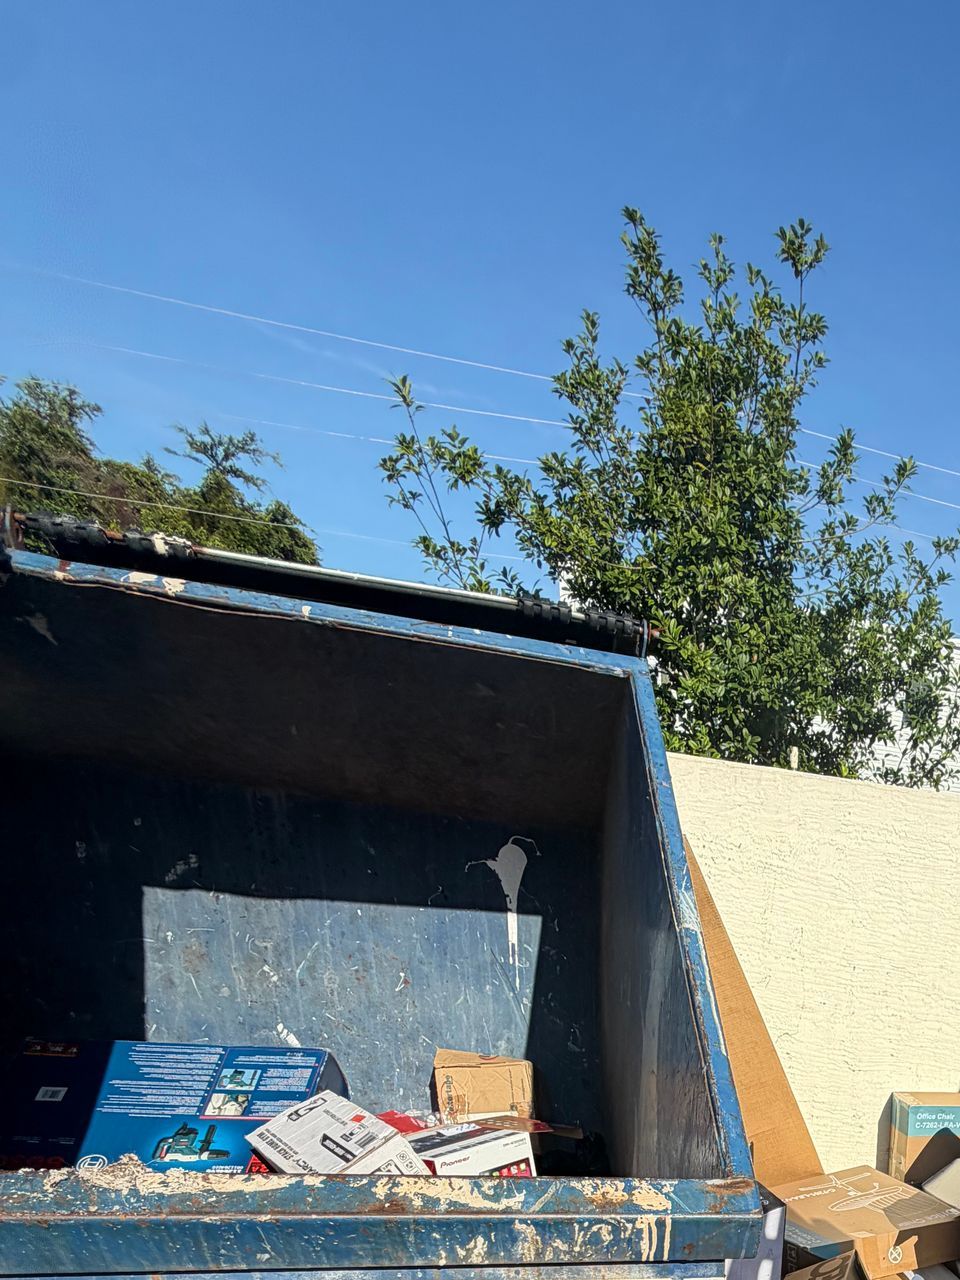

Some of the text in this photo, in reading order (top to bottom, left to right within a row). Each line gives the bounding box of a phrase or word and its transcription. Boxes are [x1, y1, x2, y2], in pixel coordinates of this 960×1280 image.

[916, 1112, 955, 1120] Office Chair
[440, 1155, 471, 1168] Pioneer
